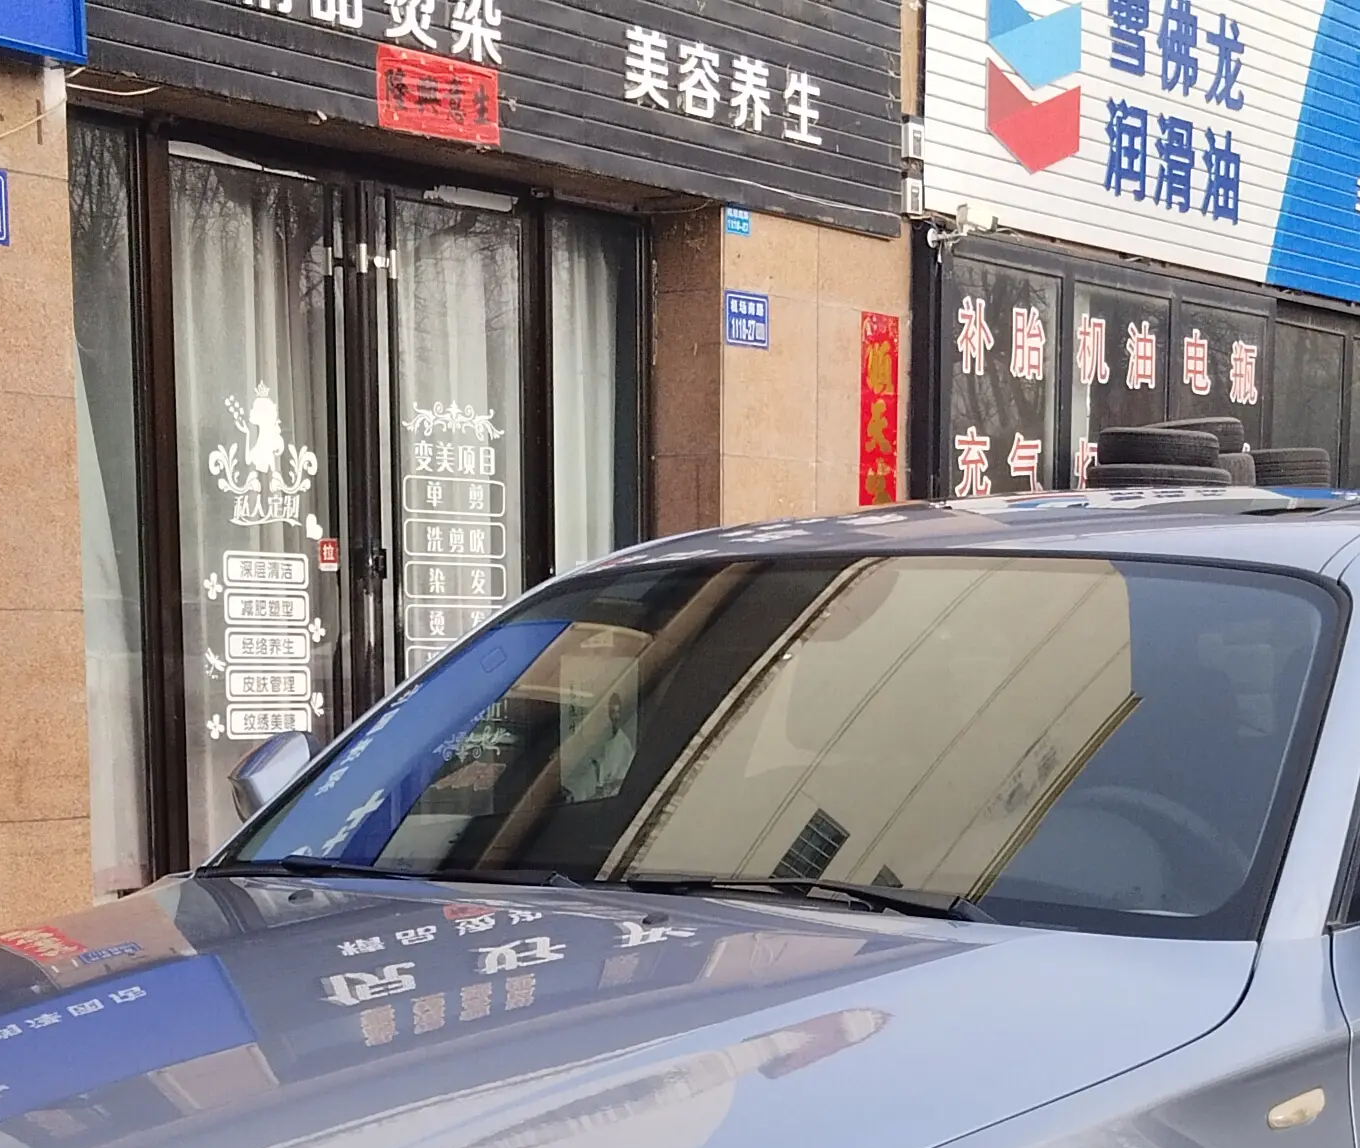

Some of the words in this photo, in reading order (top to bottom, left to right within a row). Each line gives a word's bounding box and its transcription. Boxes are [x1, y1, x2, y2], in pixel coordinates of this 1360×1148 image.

[1107, 0, 1245, 110] 雪佛龙
[624, 25, 823, 145] 美容养生
[1104, 96, 1240, 226] 润滑油
[730, 298, 765, 317] 机场南路
[414, 440, 496, 476] 变美项目
[233, 494, 301, 520] 私人定制
[426, 526, 486, 554] 洗剪吹
[322, 543, 336, 561] 拉
[240, 561, 294, 580] 深层清洁
[241, 599, 294, 618] 减肥塑型
[242, 637, 295, 656] 经络养生
[243, 675, 295, 694] 皮肤管理
